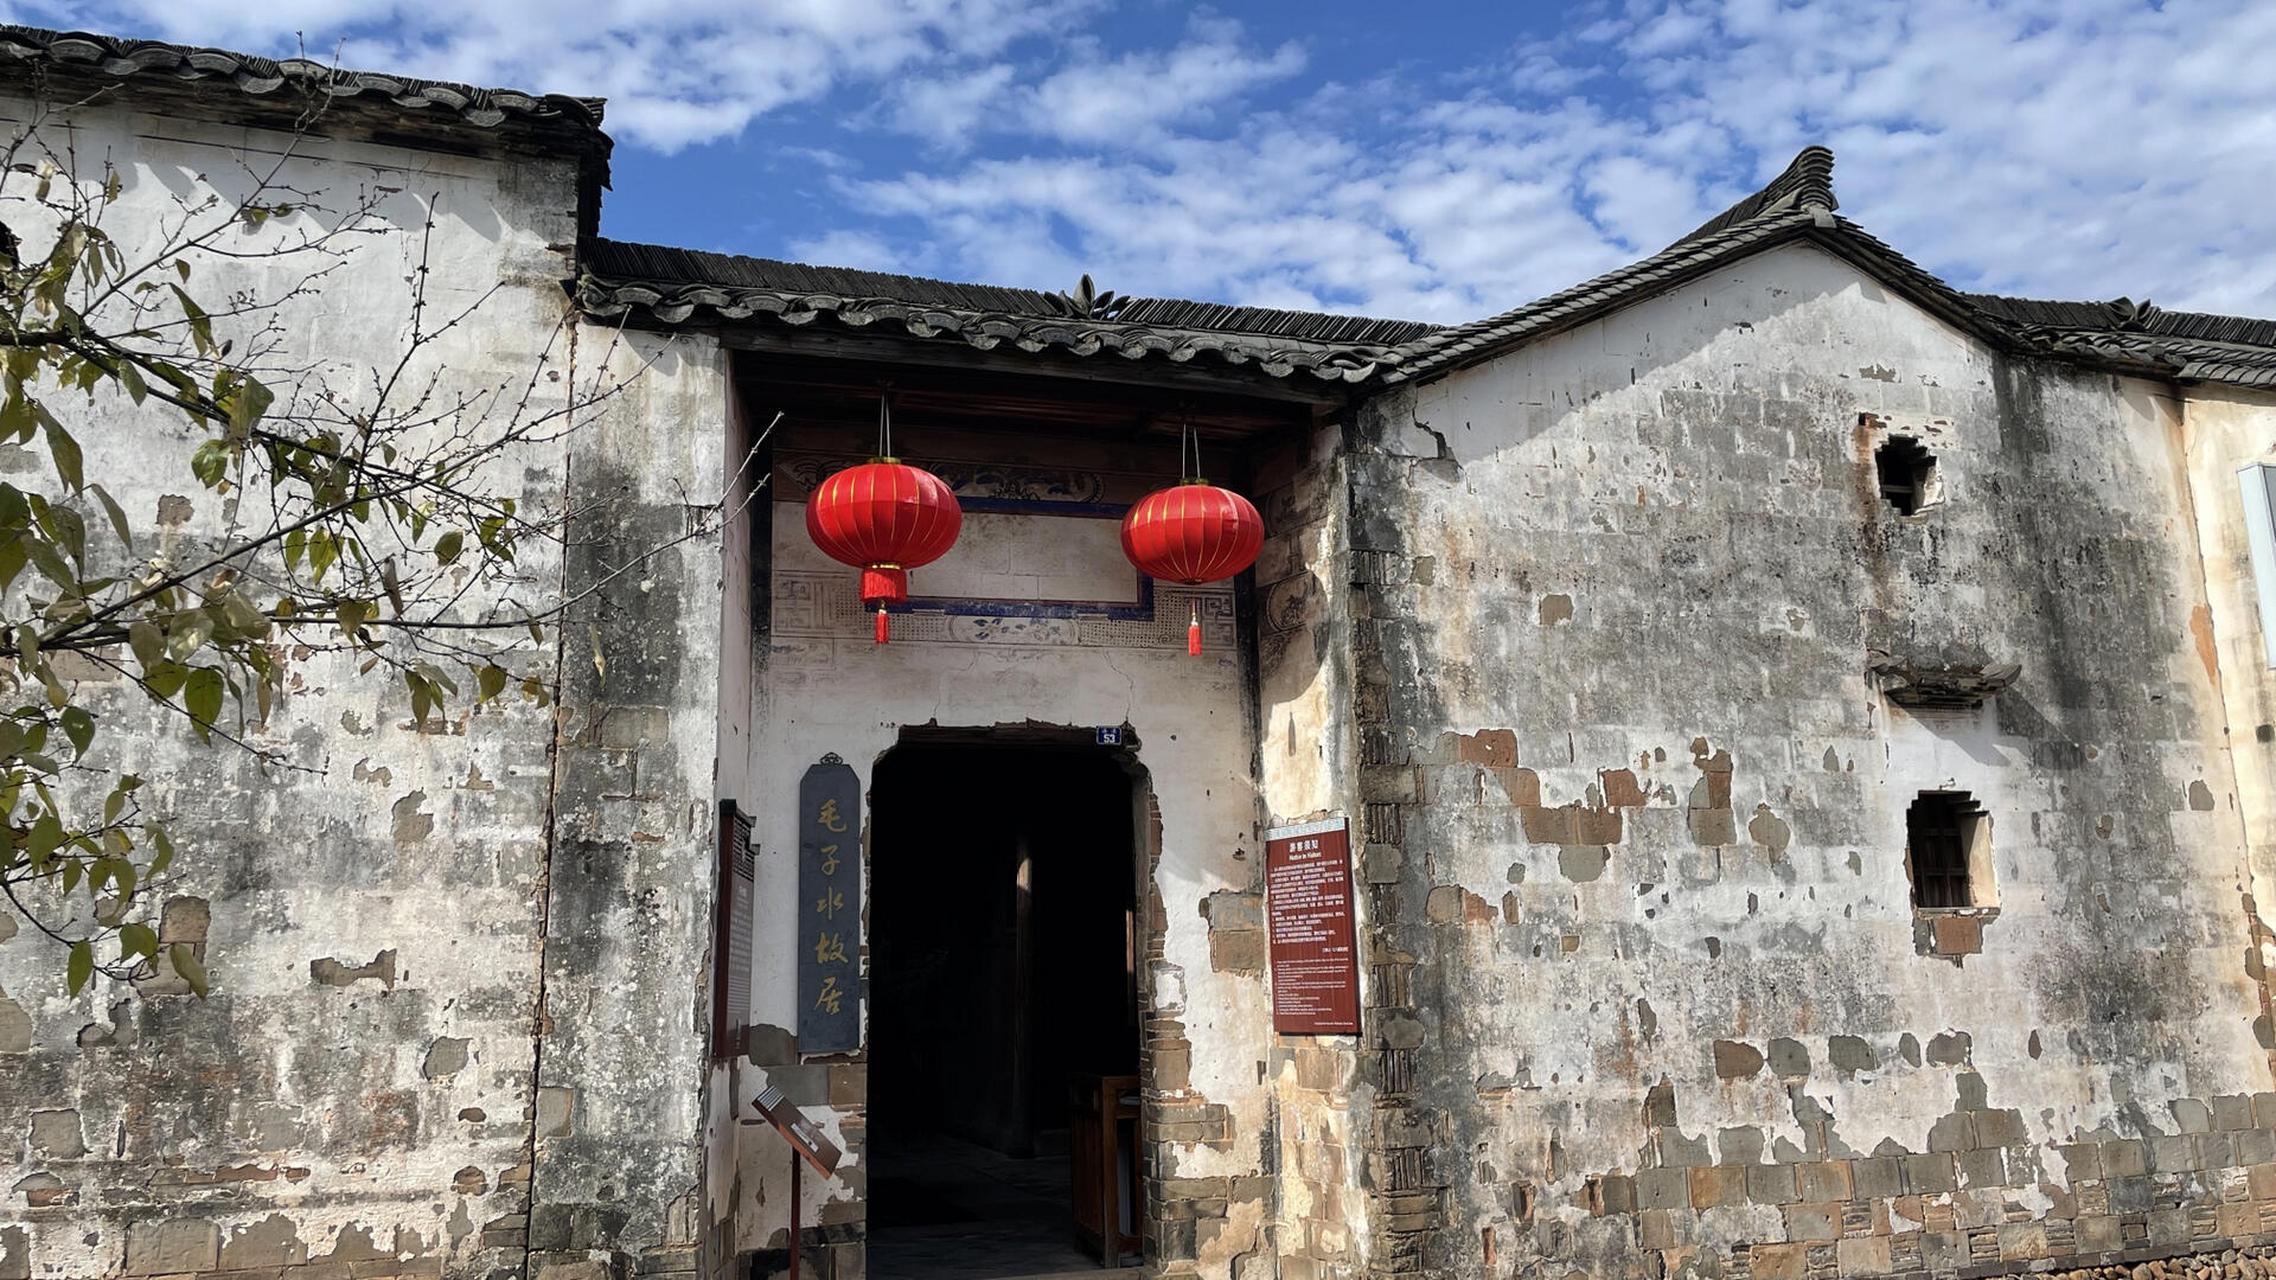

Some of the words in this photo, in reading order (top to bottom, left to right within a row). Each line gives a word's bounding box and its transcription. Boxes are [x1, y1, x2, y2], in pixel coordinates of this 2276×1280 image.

[1104, 734, 1116, 744] 53
[815, 799, 848, 1016] 毛子水故居
